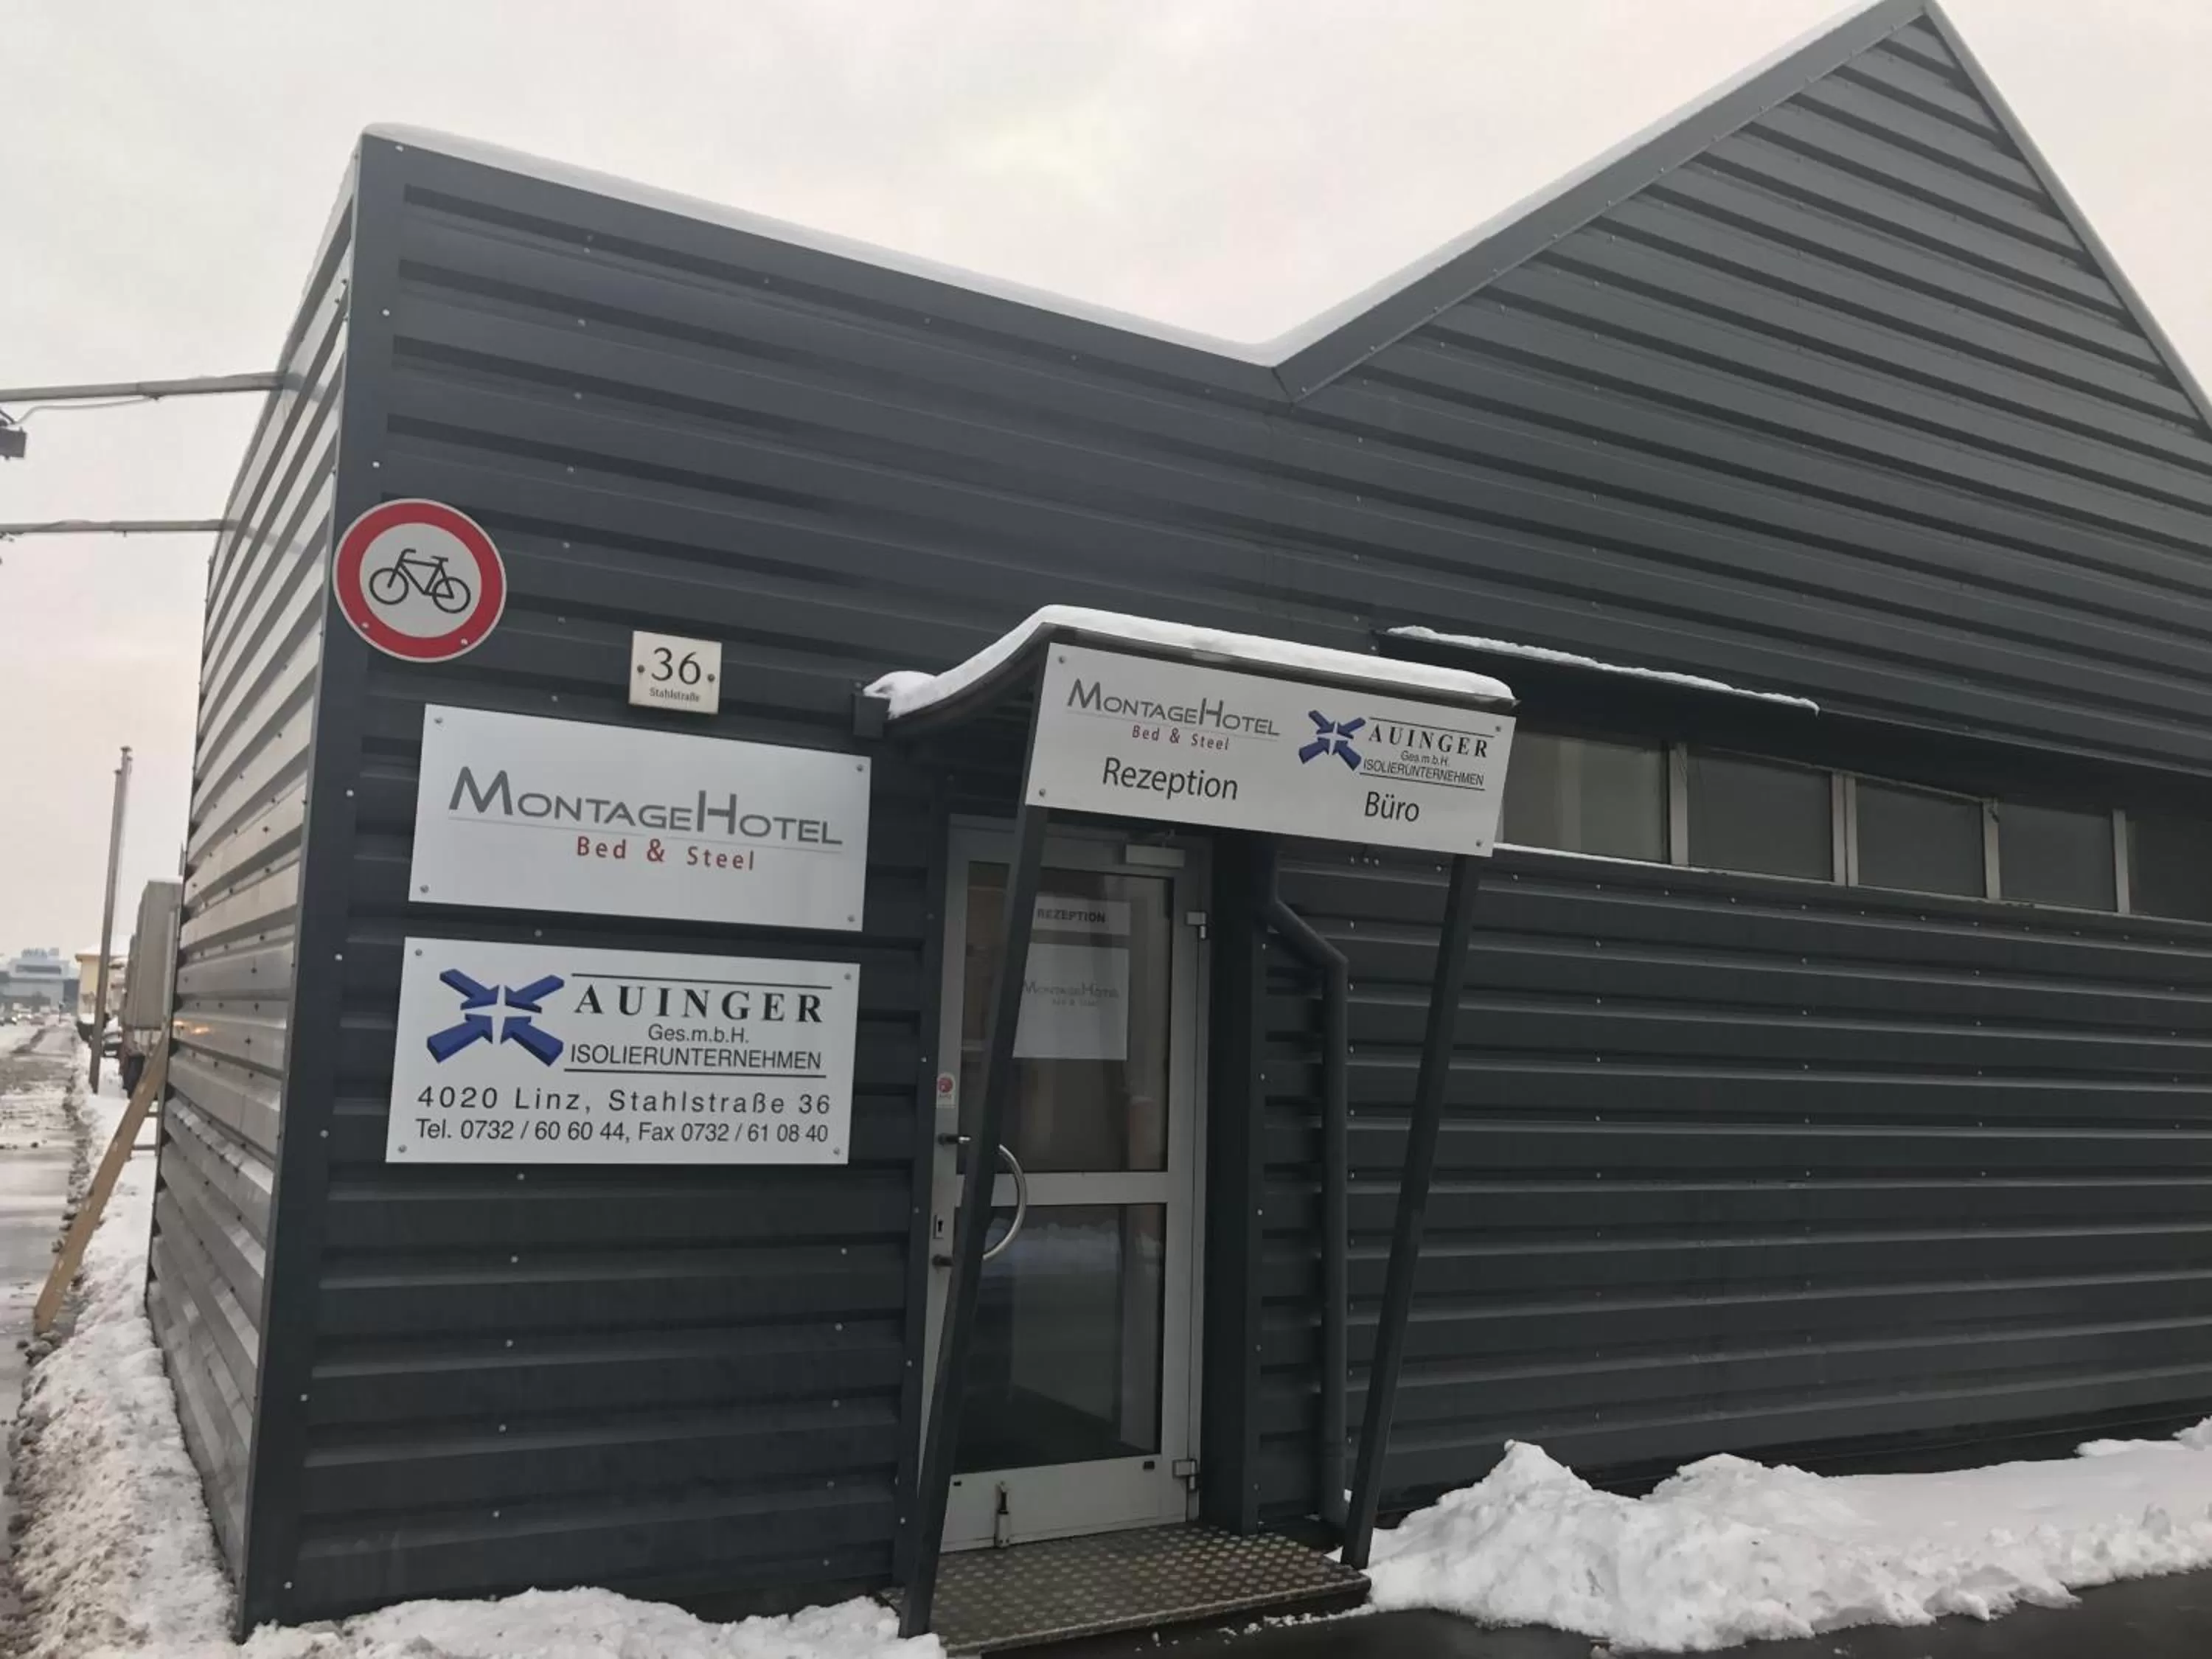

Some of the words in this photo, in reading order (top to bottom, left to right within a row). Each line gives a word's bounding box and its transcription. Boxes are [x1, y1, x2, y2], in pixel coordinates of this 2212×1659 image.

[652, 647, 700, 684] 36
[650, 687, 700, 701] Stahlstraße
[1132, 725, 1159, 742] Bed
[1169, 731, 1180, 744] &
[1191, 733, 1229, 751] Steel
[1368, 723, 1487, 757] AUINGER
[1102, 757, 1238, 800] Rezeption
[1364, 759, 1484, 786] ISOLIERUNTERNEHMEN
[1365, 791, 1419, 821] Büro
[577, 836, 626, 860] Bed
[647, 838, 665, 863] &
[687, 846, 754, 870] Steel
[1037, 908, 1106, 923] REZEPTION
[574, 984, 823, 1023] AUINGER
[648, 1023, 750, 1044] Ges.m.b.H.
[570, 1044, 822, 1069] ISOLIERUNTERNEHMEN
[417, 1086, 498, 1110] 4020
[515, 1088, 591, 1114] Linz,
[608, 1090, 785, 1114] Stahlstraße
[799, 1094, 830, 1114] 36
[415, 1119, 451, 1139] Tel.
[460, 1120, 514, 1140] 0732
[535, 1121, 561, 1141] 60
[568, 1121, 593, 1141] 60
[600, 1122, 630, 1144] 44,
[639, 1122, 675, 1142] Fax
[681, 1123, 729, 1142] 0732
[748, 1124, 769, 1142] 61
[776, 1124, 799, 1143] 08
[805, 1124, 828, 1143] 40
